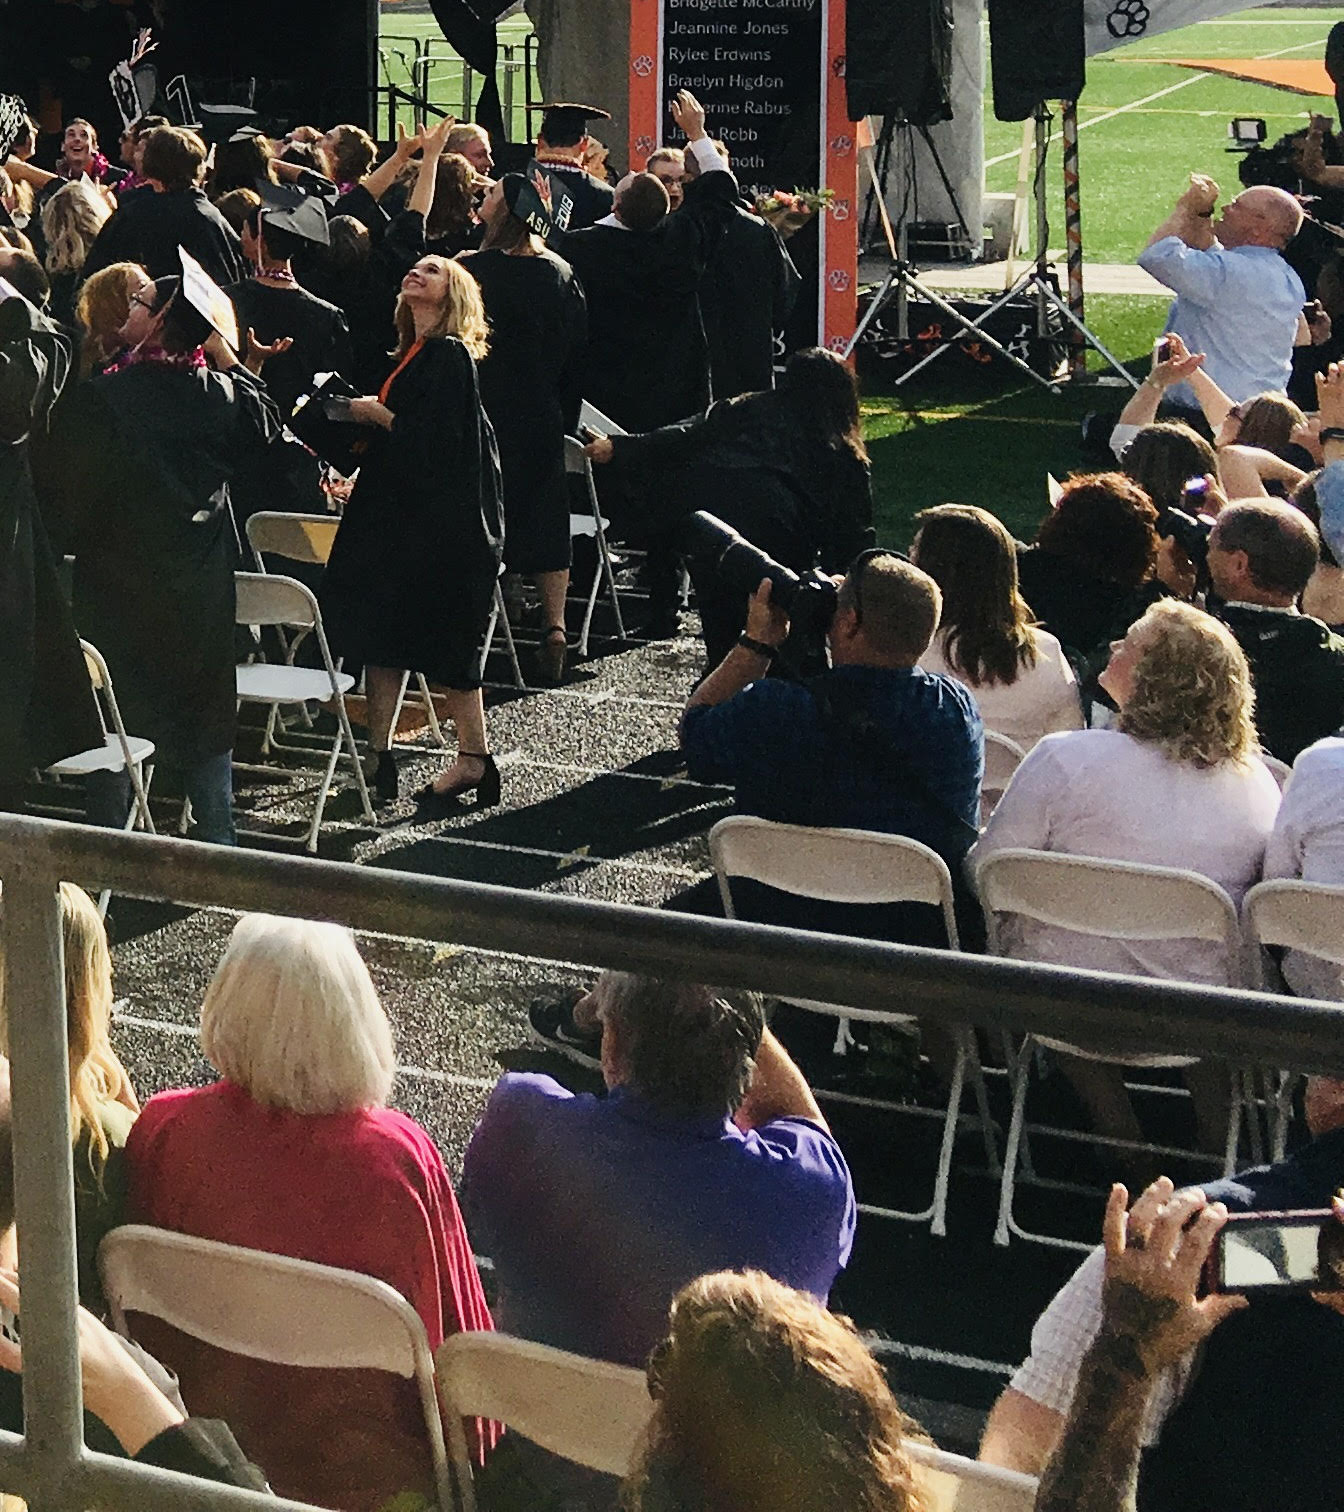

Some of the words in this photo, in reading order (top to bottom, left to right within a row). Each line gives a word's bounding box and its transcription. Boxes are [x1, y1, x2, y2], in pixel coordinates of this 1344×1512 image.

[669, 21, 738, 34] Jeannine
[743, 21, 789, 34] Jones
[668, 47, 709, 64] Rylee
[668, 74, 724, 90] Braelyn
[729, 74, 784, 90] Higdon
[744, 100, 792, 114] Rabus
[719, 127, 758, 141] Robb
[554, 193, 574, 232] 2018
[526, 211, 551, 239] ASU
